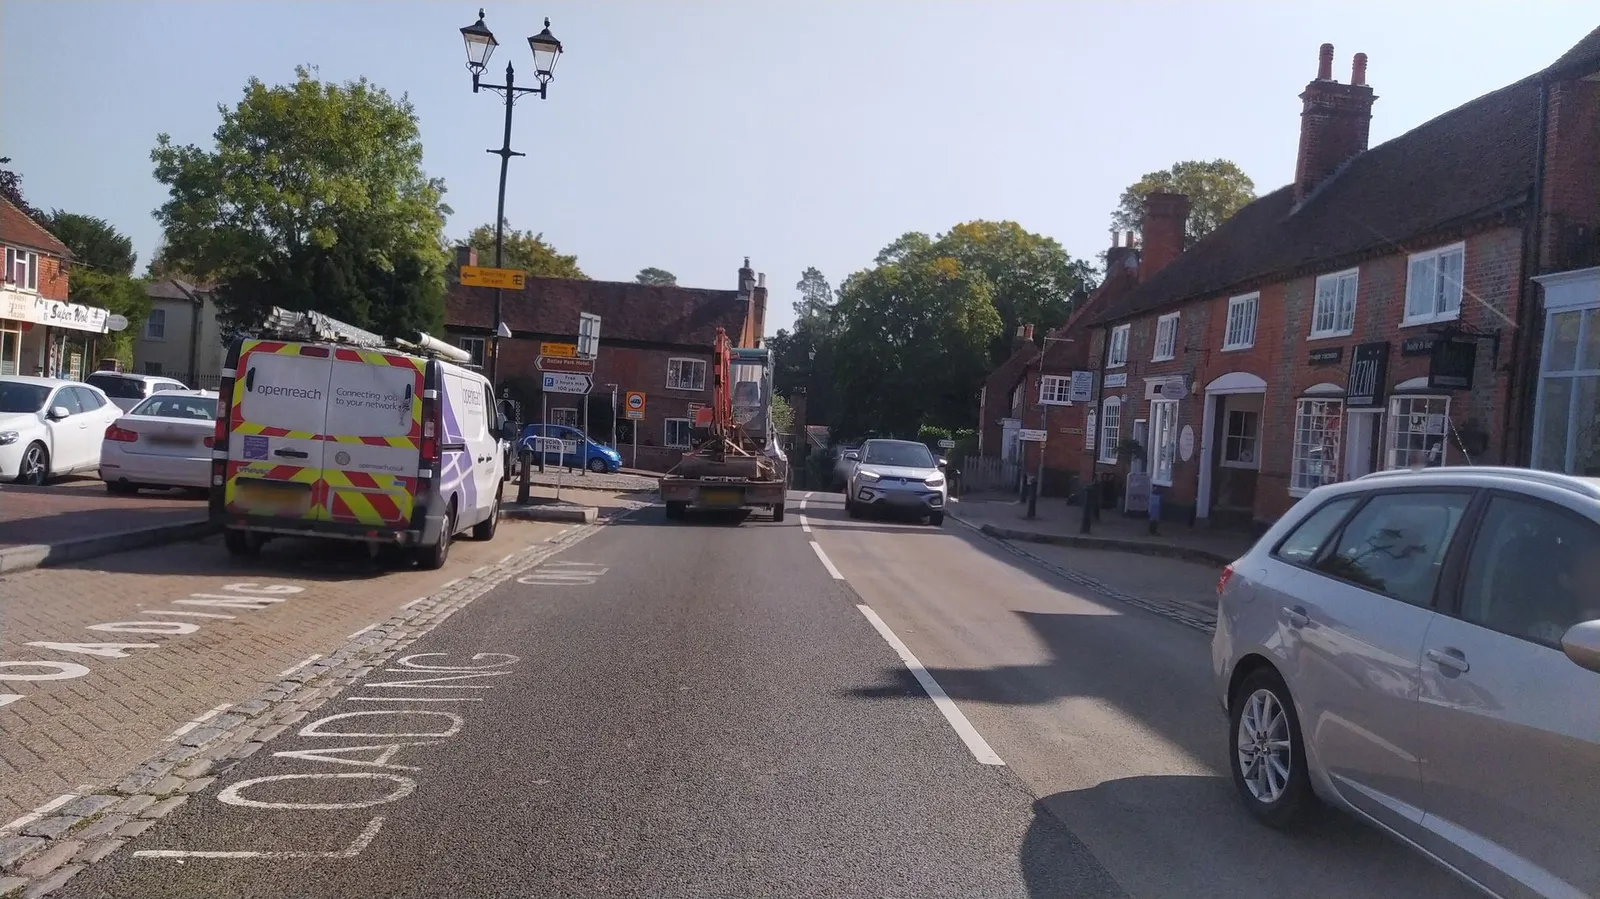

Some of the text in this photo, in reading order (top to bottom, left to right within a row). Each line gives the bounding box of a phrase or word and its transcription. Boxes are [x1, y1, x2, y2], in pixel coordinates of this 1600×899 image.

[50, 303, 72, 323] Super
[74, 306, 89, 323] Wok
[257, 385, 321, 400] openreach
[336, 388, 380, 401] Connecting
[346, 400, 362, 408] your
[0, 583, 305, 706] OADING
[133, 560, 610, 859] LOADING ONLY
